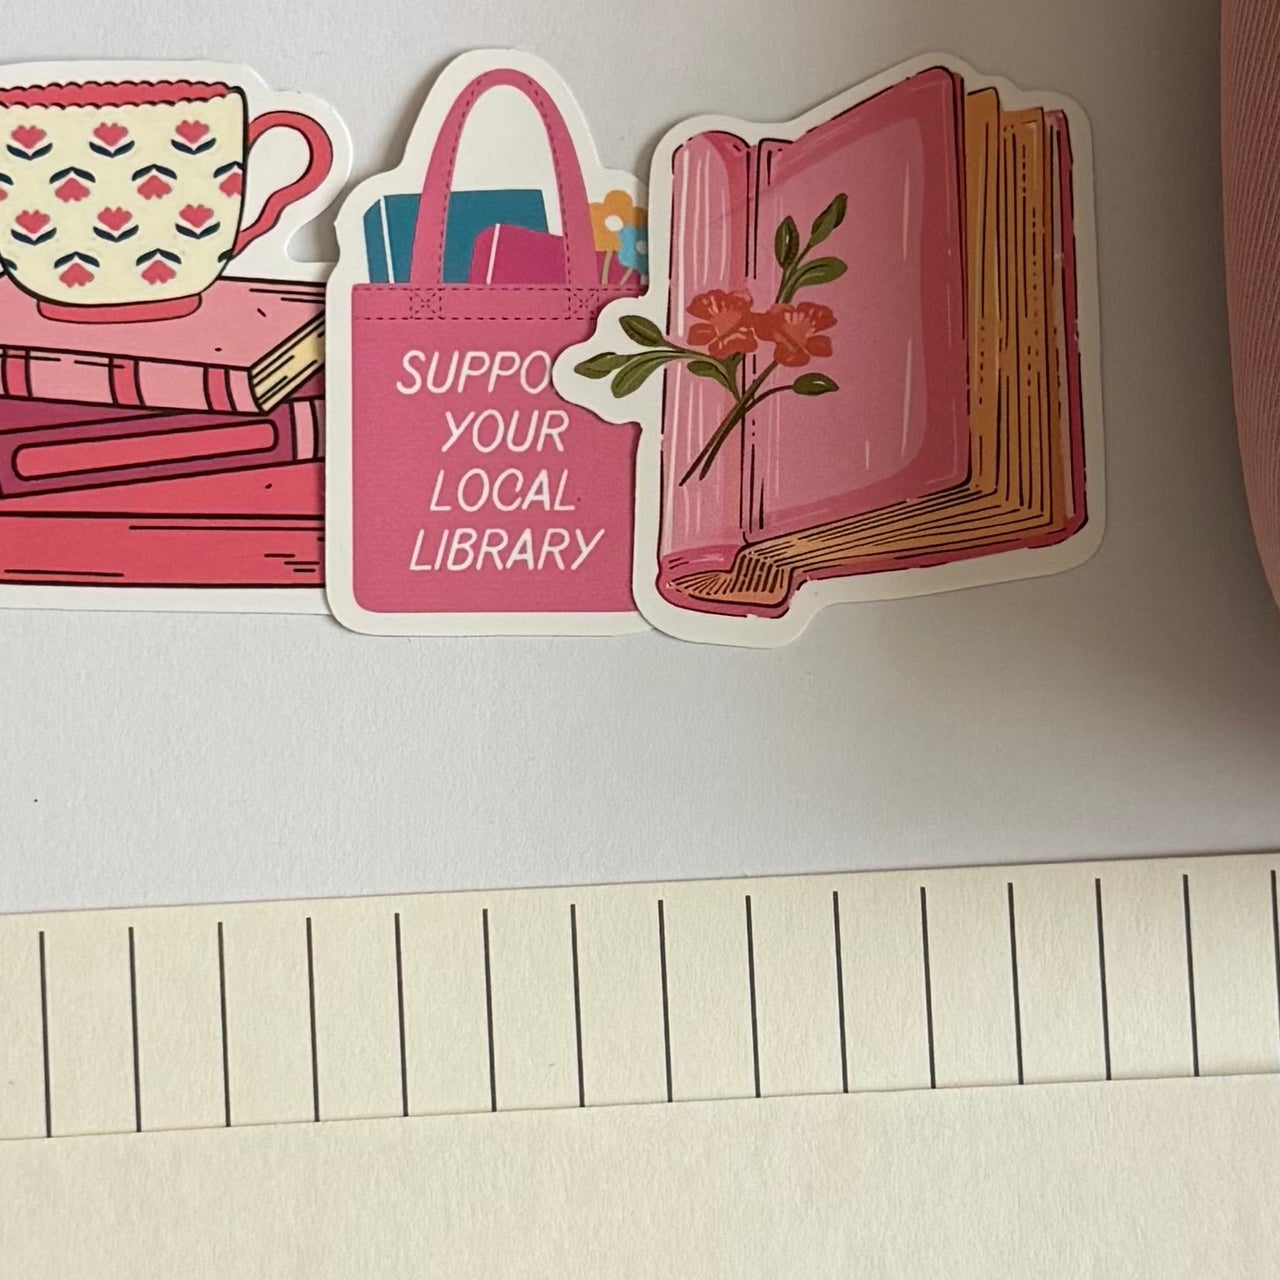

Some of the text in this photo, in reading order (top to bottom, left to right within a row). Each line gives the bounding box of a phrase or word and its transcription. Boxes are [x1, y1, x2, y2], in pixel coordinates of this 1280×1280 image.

[396, 349, 553, 395] SUPPO
[440, 408, 570, 454] YOUR
[429, 467, 576, 512] LOCAL
[409, 527, 606, 571] LIBRARY
